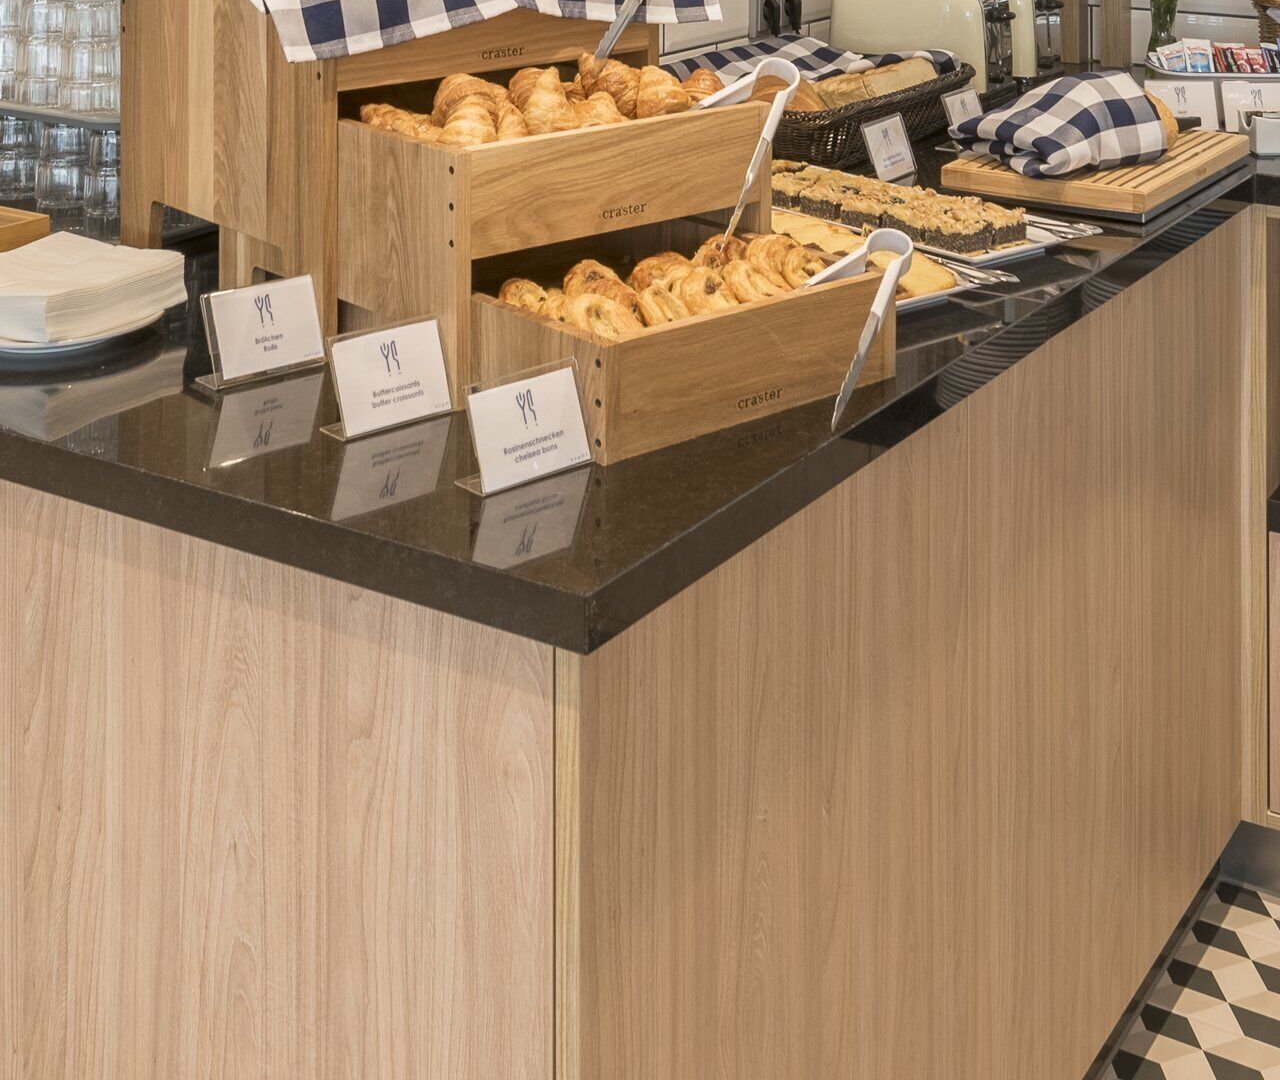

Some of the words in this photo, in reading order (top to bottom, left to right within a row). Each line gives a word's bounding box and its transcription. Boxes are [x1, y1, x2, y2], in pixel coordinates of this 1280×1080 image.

[602, 202, 648, 220] craster
[371, 398, 391, 409] butter
[392, 389, 425, 404] croissants
[738, 388, 784, 410] craster
[503, 429, 565, 456] Rosinenschnecken
[514, 448, 541, 463] chelsea
[541, 443, 558, 455] buns
